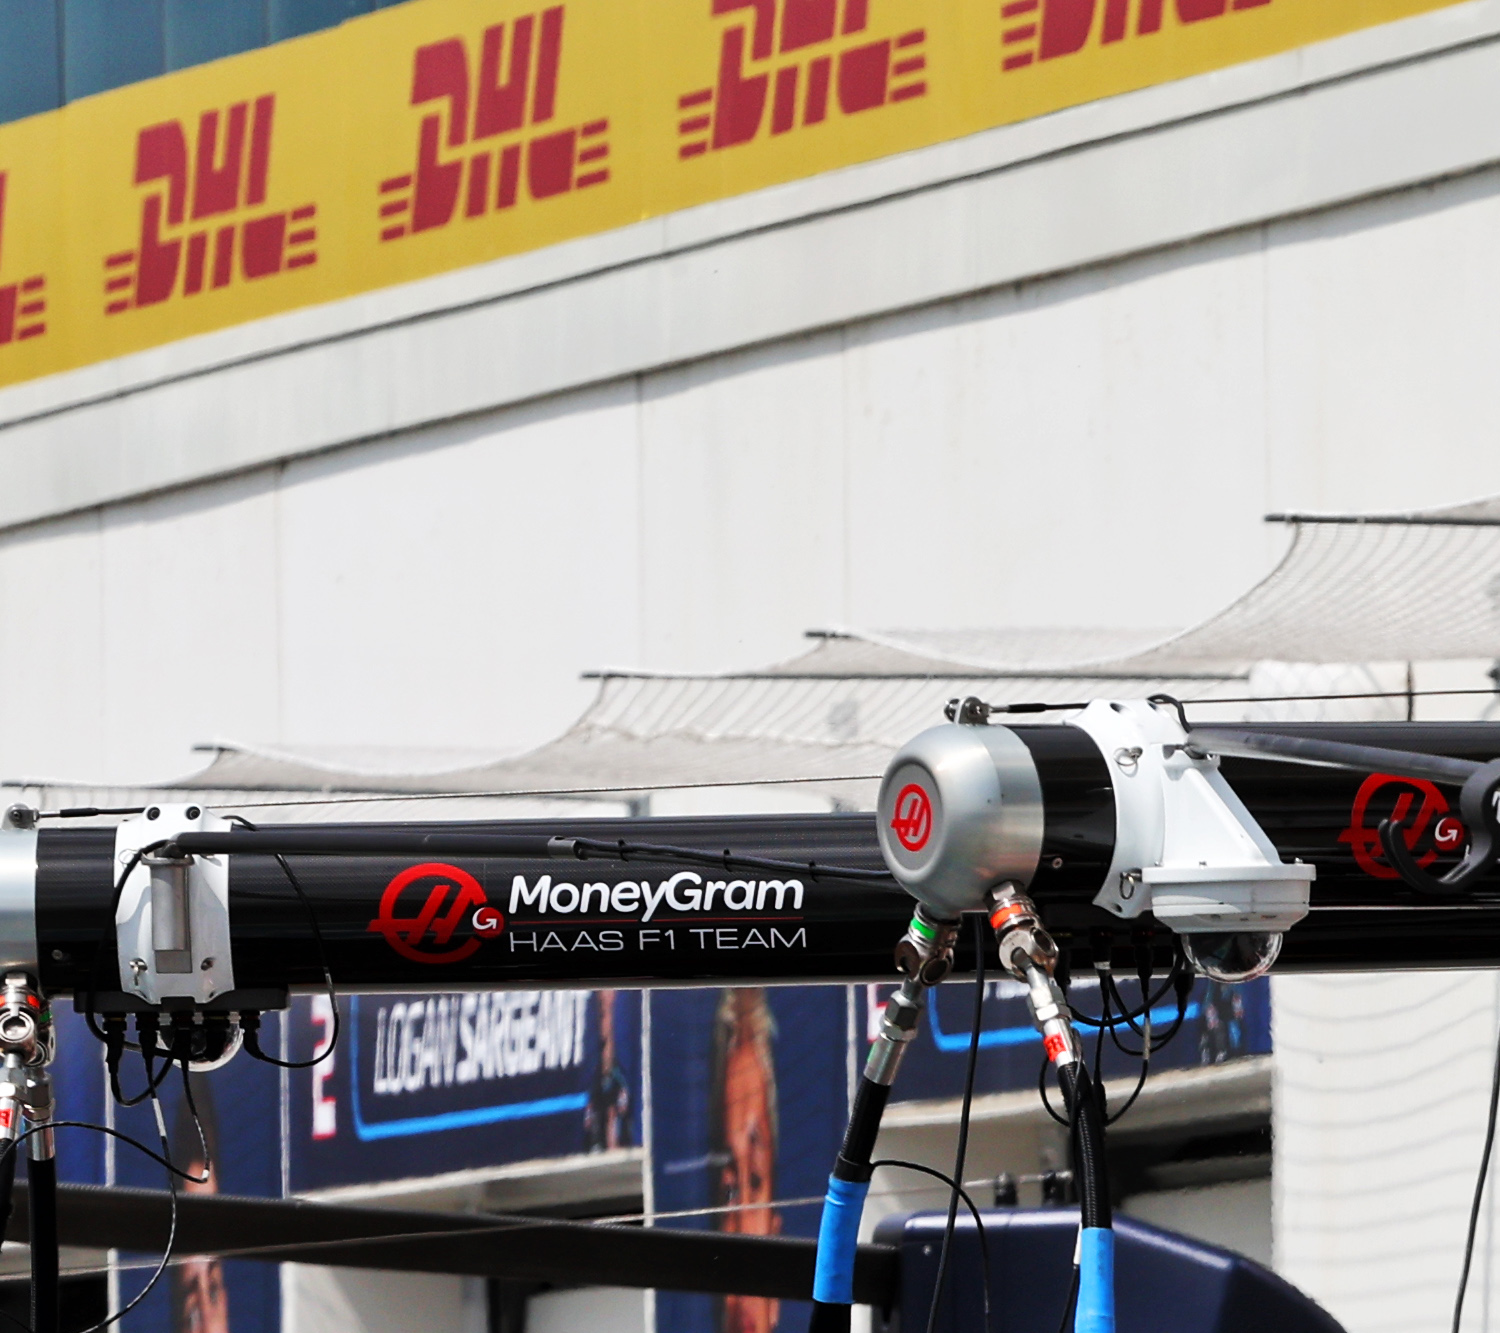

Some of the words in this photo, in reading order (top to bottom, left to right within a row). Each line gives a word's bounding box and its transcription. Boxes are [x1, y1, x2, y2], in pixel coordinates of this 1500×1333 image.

[410, 5, 578, 234] DHL
[133, 92, 288, 308] DHL
[508, 871, 804, 922] MoneyGram
[509, 930, 625, 953] HAAS
[639, 929, 676, 951] F1
[689, 927, 807, 950] TEAM
